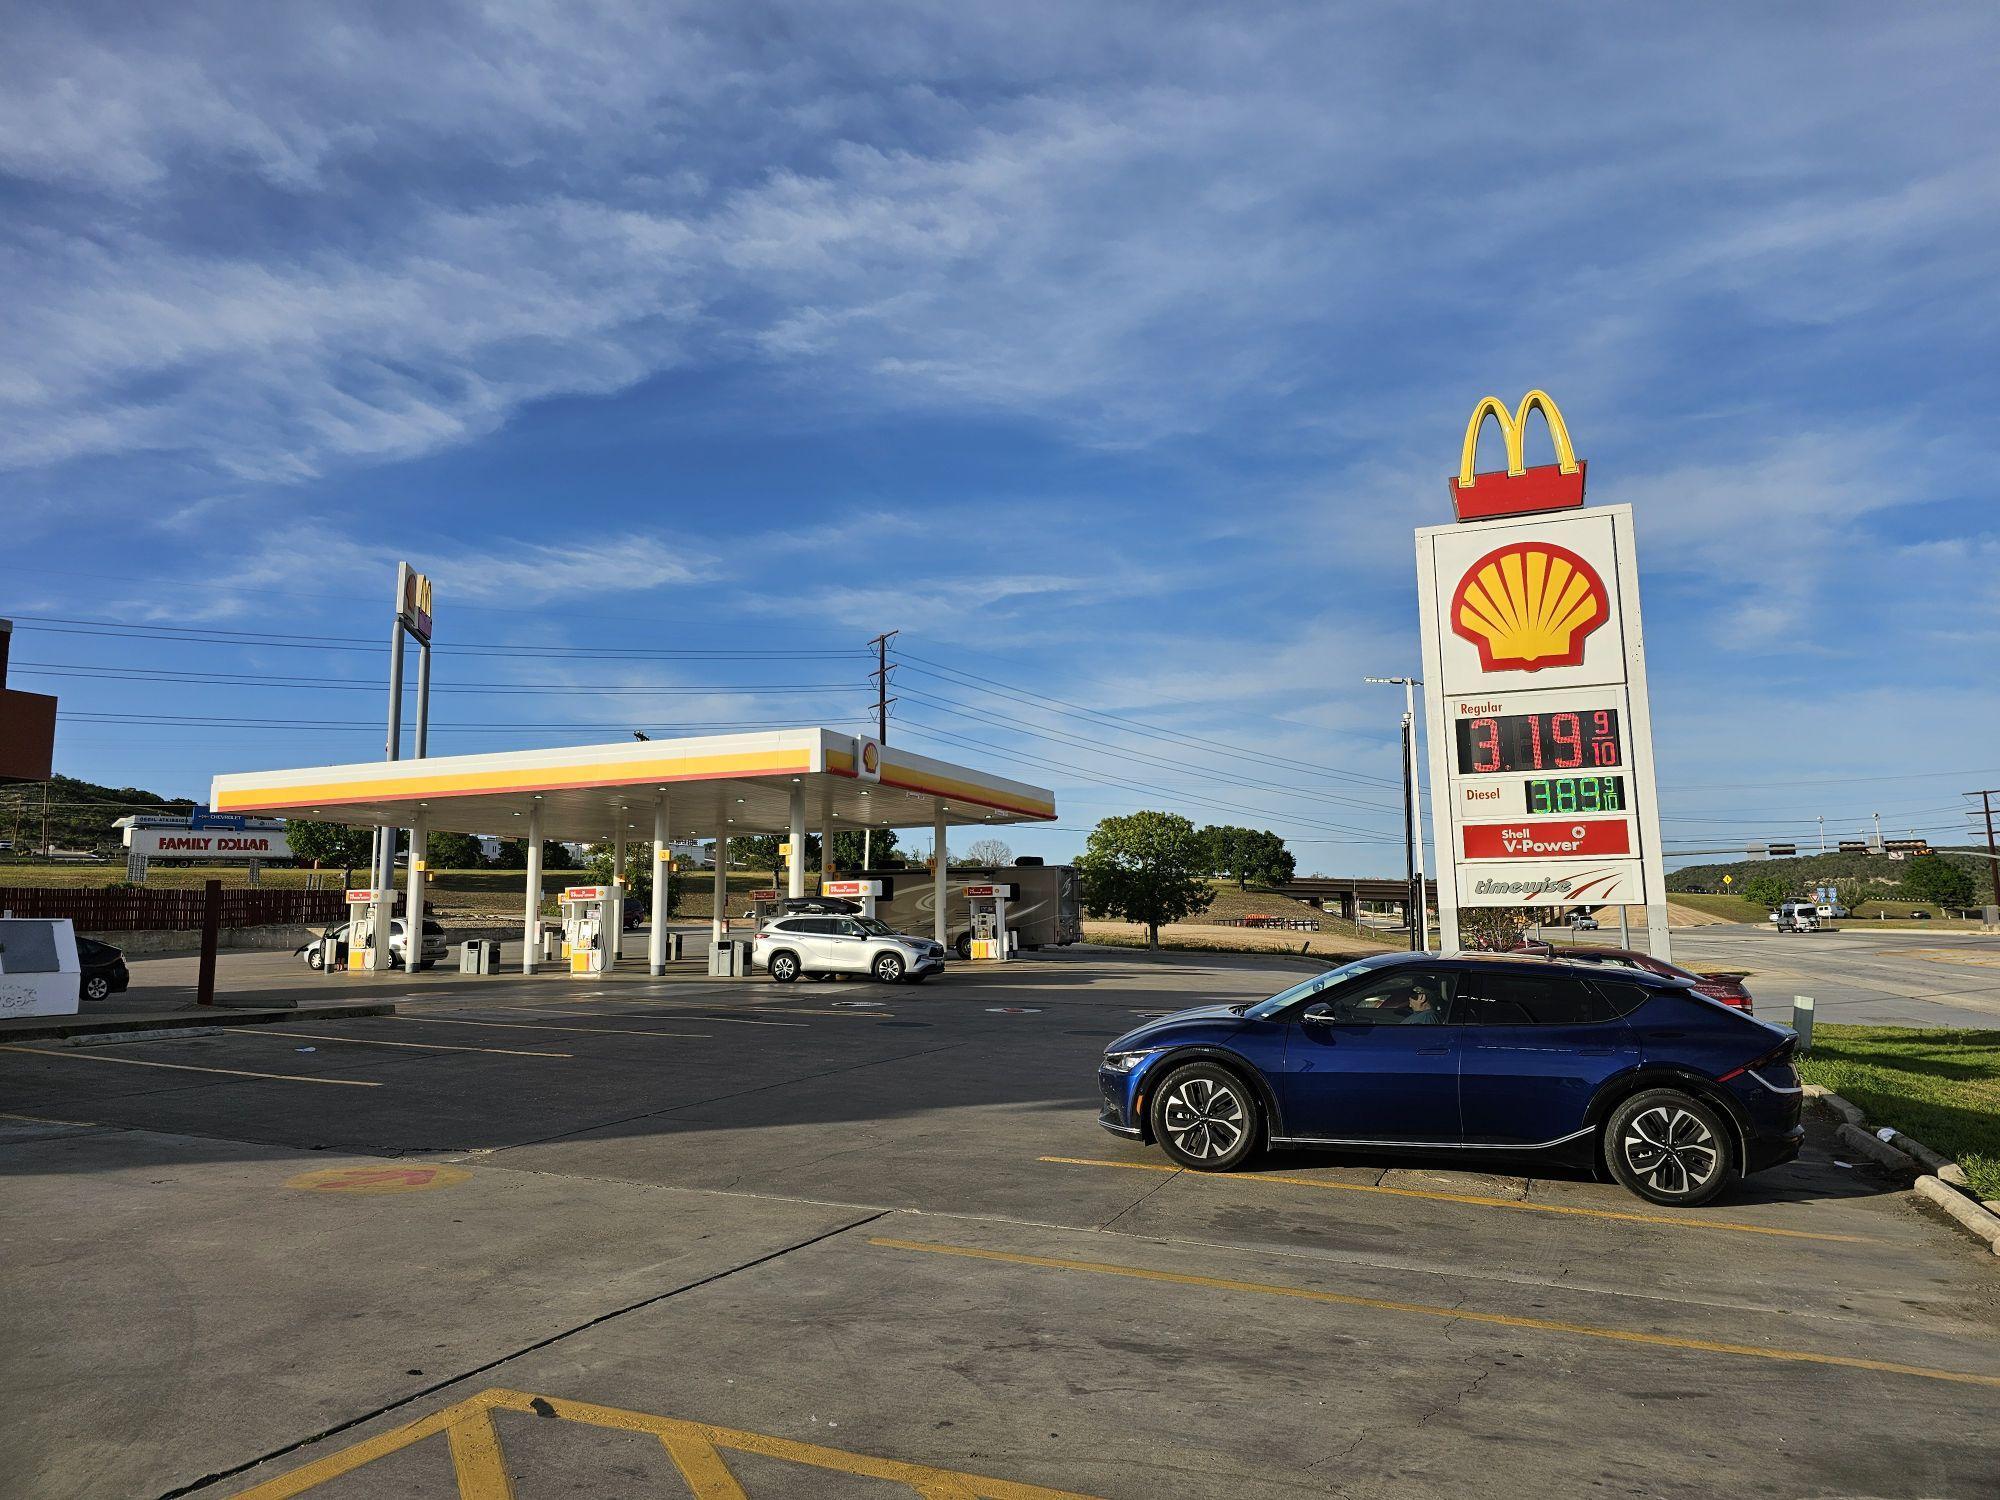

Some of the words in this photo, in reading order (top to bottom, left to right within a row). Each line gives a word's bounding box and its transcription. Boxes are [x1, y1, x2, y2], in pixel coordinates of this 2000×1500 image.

[1460, 702, 1503, 716] Regular
[1466, 788, 1500, 801] Diesel
[1501, 828, 1530, 839] Shell
[159, 837, 211, 850] FAMILY
[217, 838, 269, 851] DOLLAR
[1502, 840, 1580, 853] V-Power
[1474, 877, 1572, 895] timewise
